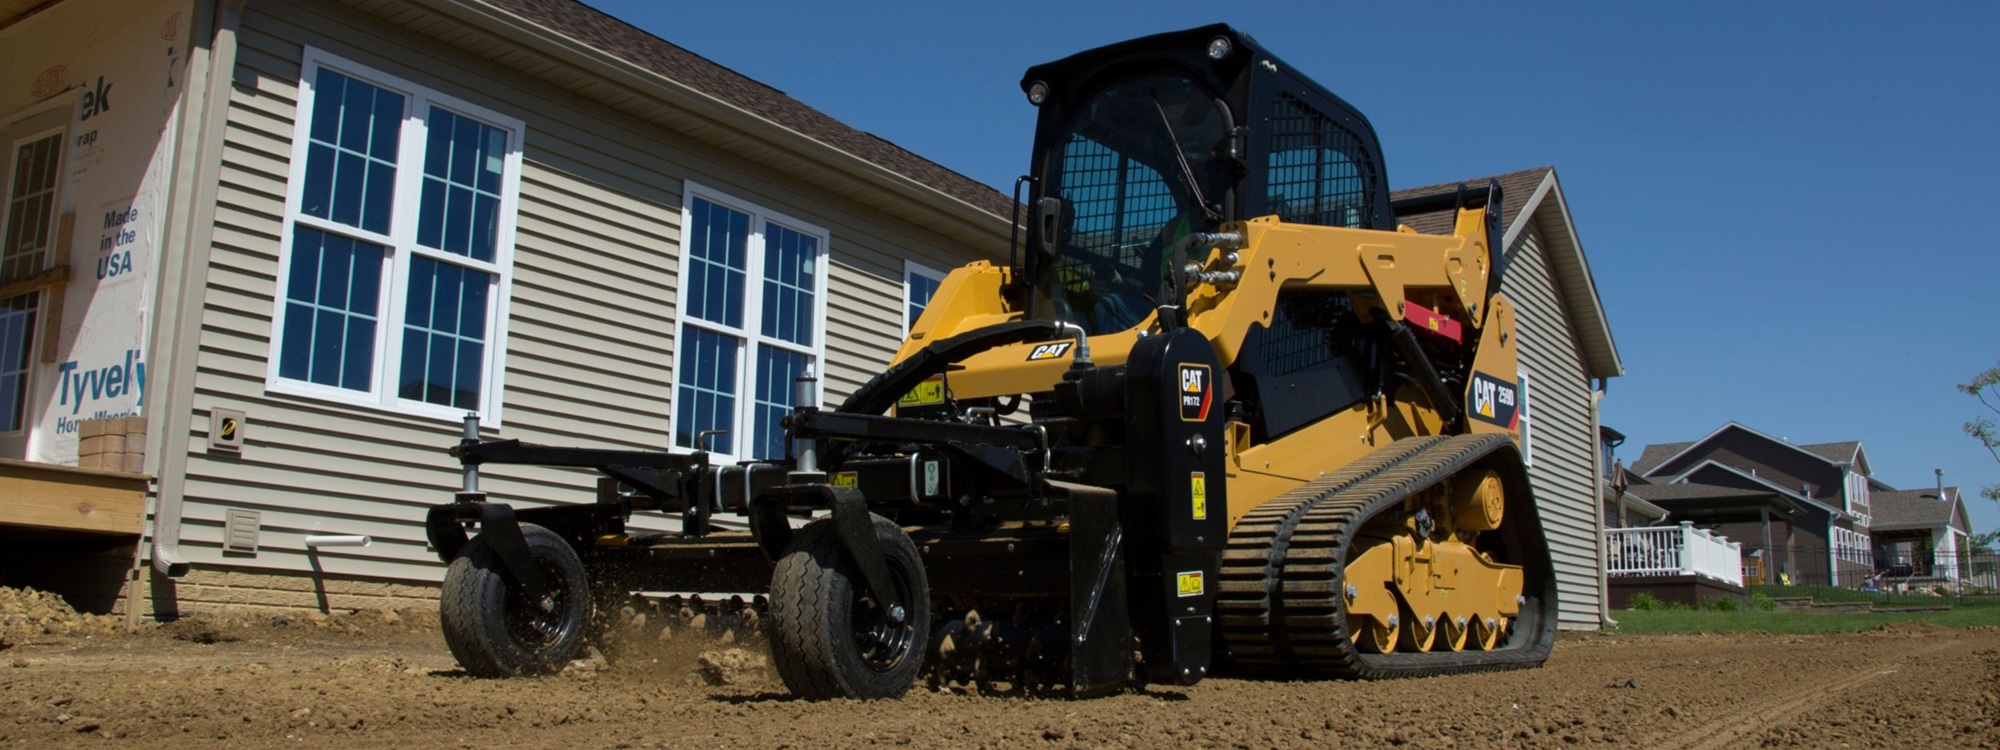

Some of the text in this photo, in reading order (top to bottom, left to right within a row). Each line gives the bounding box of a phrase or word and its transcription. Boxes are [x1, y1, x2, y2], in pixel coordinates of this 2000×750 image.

[104, 206, 138, 230] Made
[101, 229, 136, 251] in the
[97, 250, 132, 281] USA
[1030, 343, 1070, 359] CAT
[1182, 369, 1202, 392] CAT
[1183, 395, 1200, 406] PR172
[1474, 377, 1514, 418] CAT 259D
